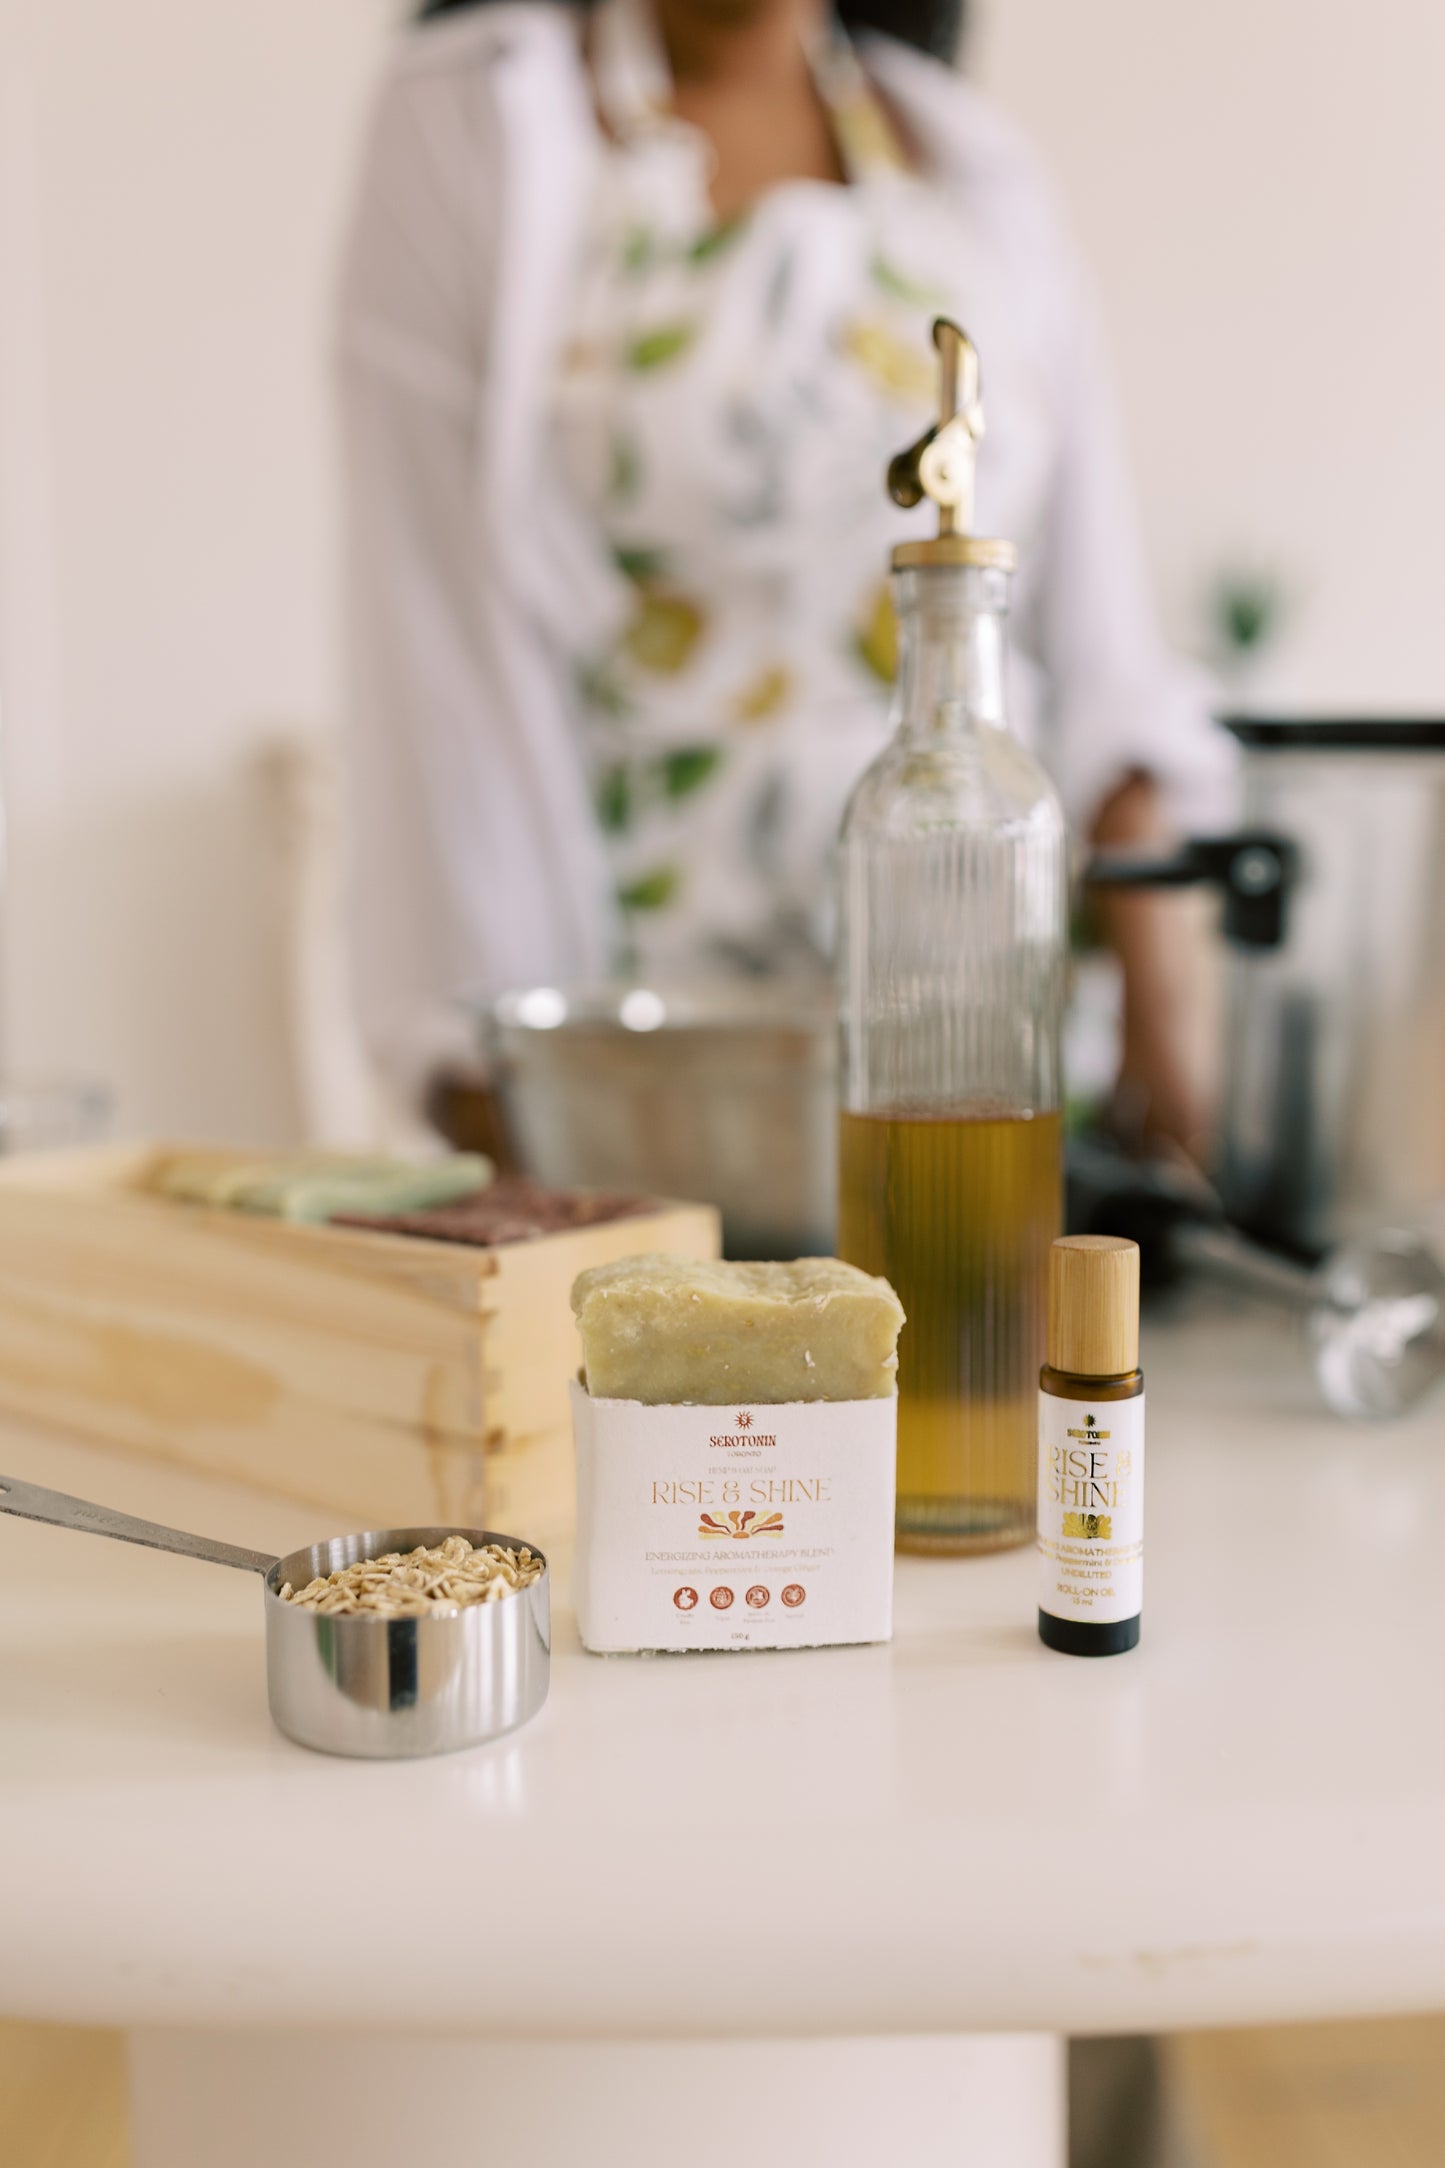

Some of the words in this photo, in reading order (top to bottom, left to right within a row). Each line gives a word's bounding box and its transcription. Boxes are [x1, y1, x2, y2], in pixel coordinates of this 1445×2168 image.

[709, 1435, 777, 1447] SEROTONIN
[1046, 1445, 1108, 1478] RISE
[652, 1480, 714, 1504] RISE
[722, 1480, 740, 1503] &
[750, 1478, 832, 1502] SHINE
[645, 1551, 712, 1561] ENERGIZING
[713, 1549, 798, 1560] AROMATHERAPY
[1056, 1583, 1098, 1597] ROLL-ON
